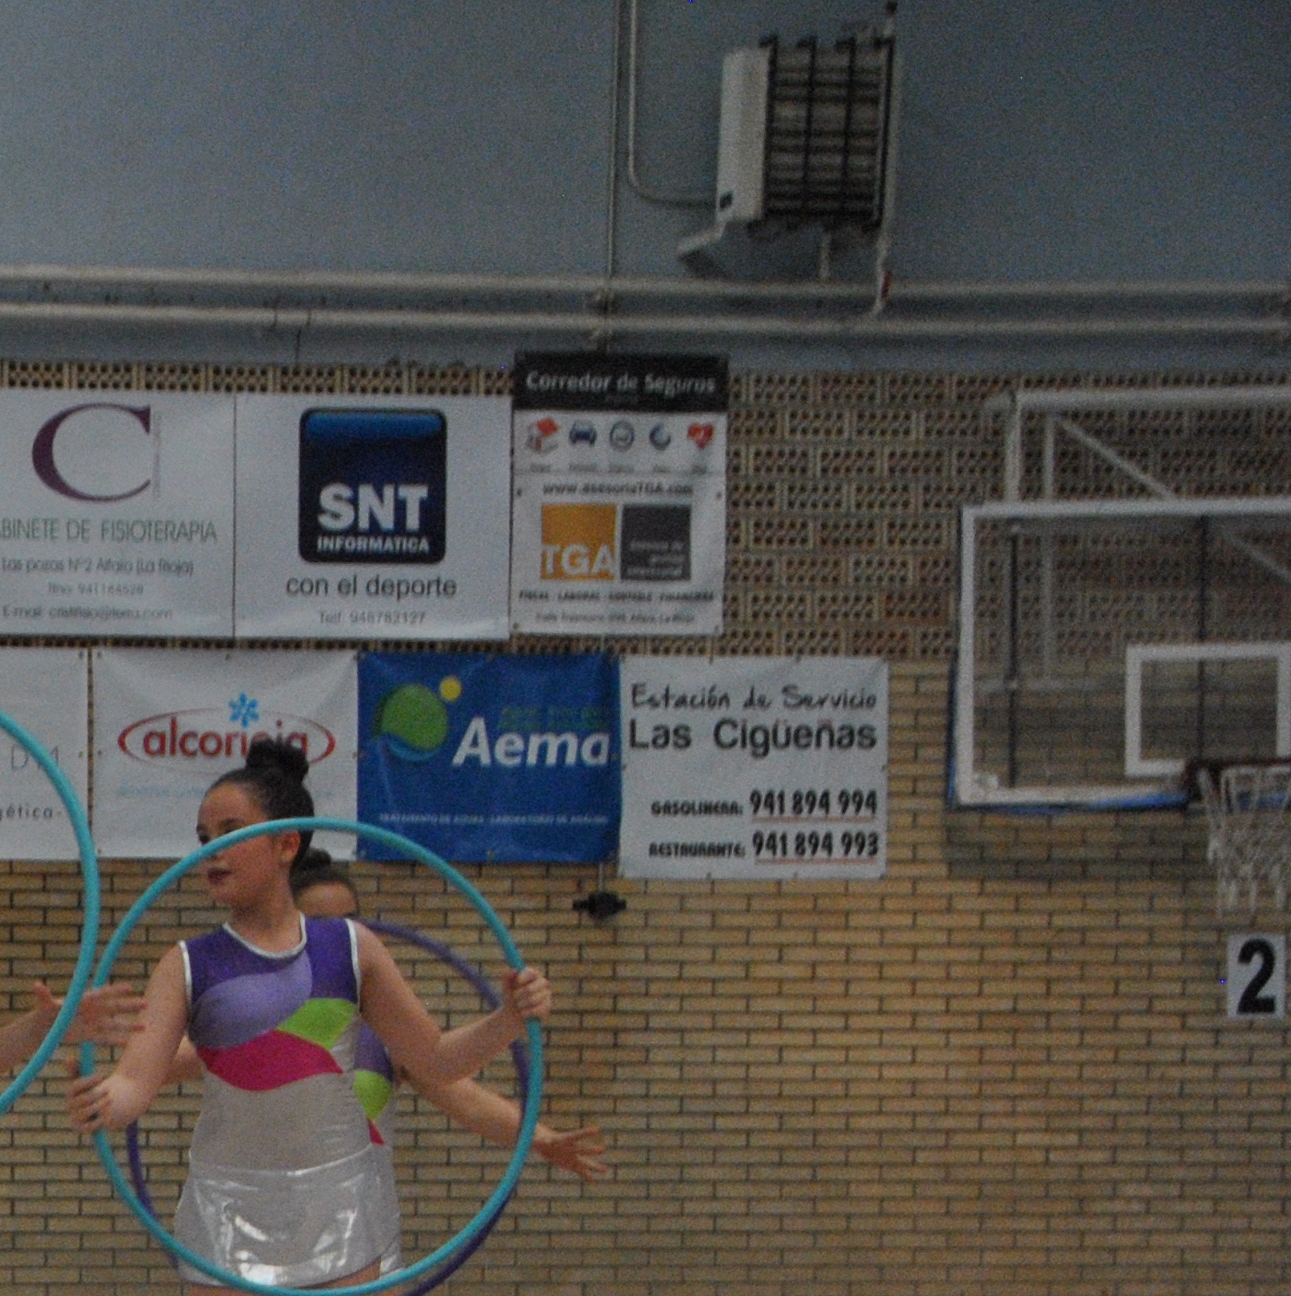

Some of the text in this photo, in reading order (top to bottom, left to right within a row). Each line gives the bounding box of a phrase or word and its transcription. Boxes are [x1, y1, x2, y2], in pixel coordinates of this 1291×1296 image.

[525, 370, 716, 398] Corredor de Seguros
[31, 402, 152, 504] C
[317, 481, 430, 533] SNT
[66, 519, 92, 541] DE
[100, 519, 218, 545] FISIOTERAPIA
[542, 544, 616, 575] TGA
[285, 574, 458, 600] con el deporte
[631, 683, 878, 710] Estación de Servicio
[452, 716, 610, 768] Aema
[629, 717, 693, 750] Las
[713, 717, 878, 758] Cigüeñas
[750, 789, 878, 816] 941 894 994
[752, 831, 879, 857] 941 894 993
[1236, 937, 1277, 1015] 2
